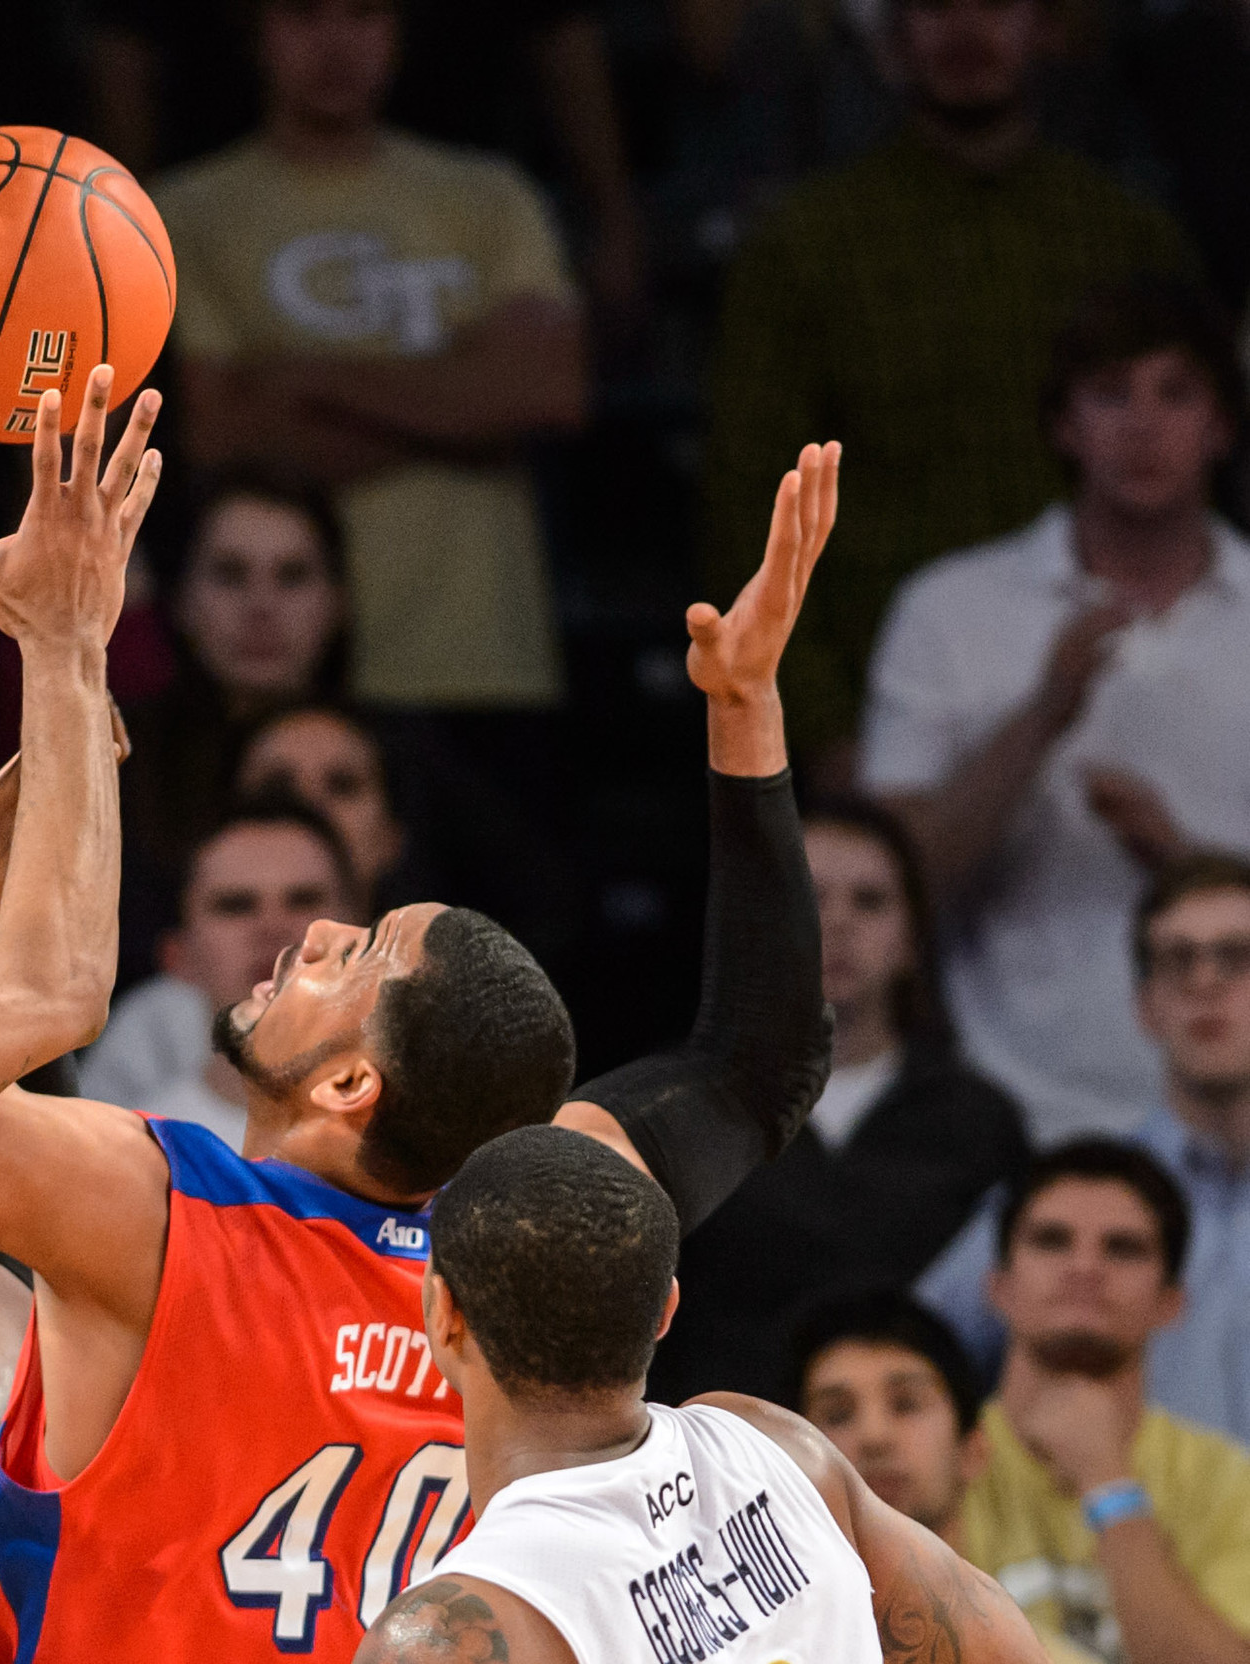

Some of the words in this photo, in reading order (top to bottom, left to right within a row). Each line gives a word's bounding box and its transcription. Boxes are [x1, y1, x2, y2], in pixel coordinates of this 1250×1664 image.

[267, 231, 475, 356] GT
[376, 1217, 424, 1250] A10
[330, 1322, 449, 1399] SCOT
[645, 1471, 695, 1529] ACC
[219, 1441, 475, 1654] 40
